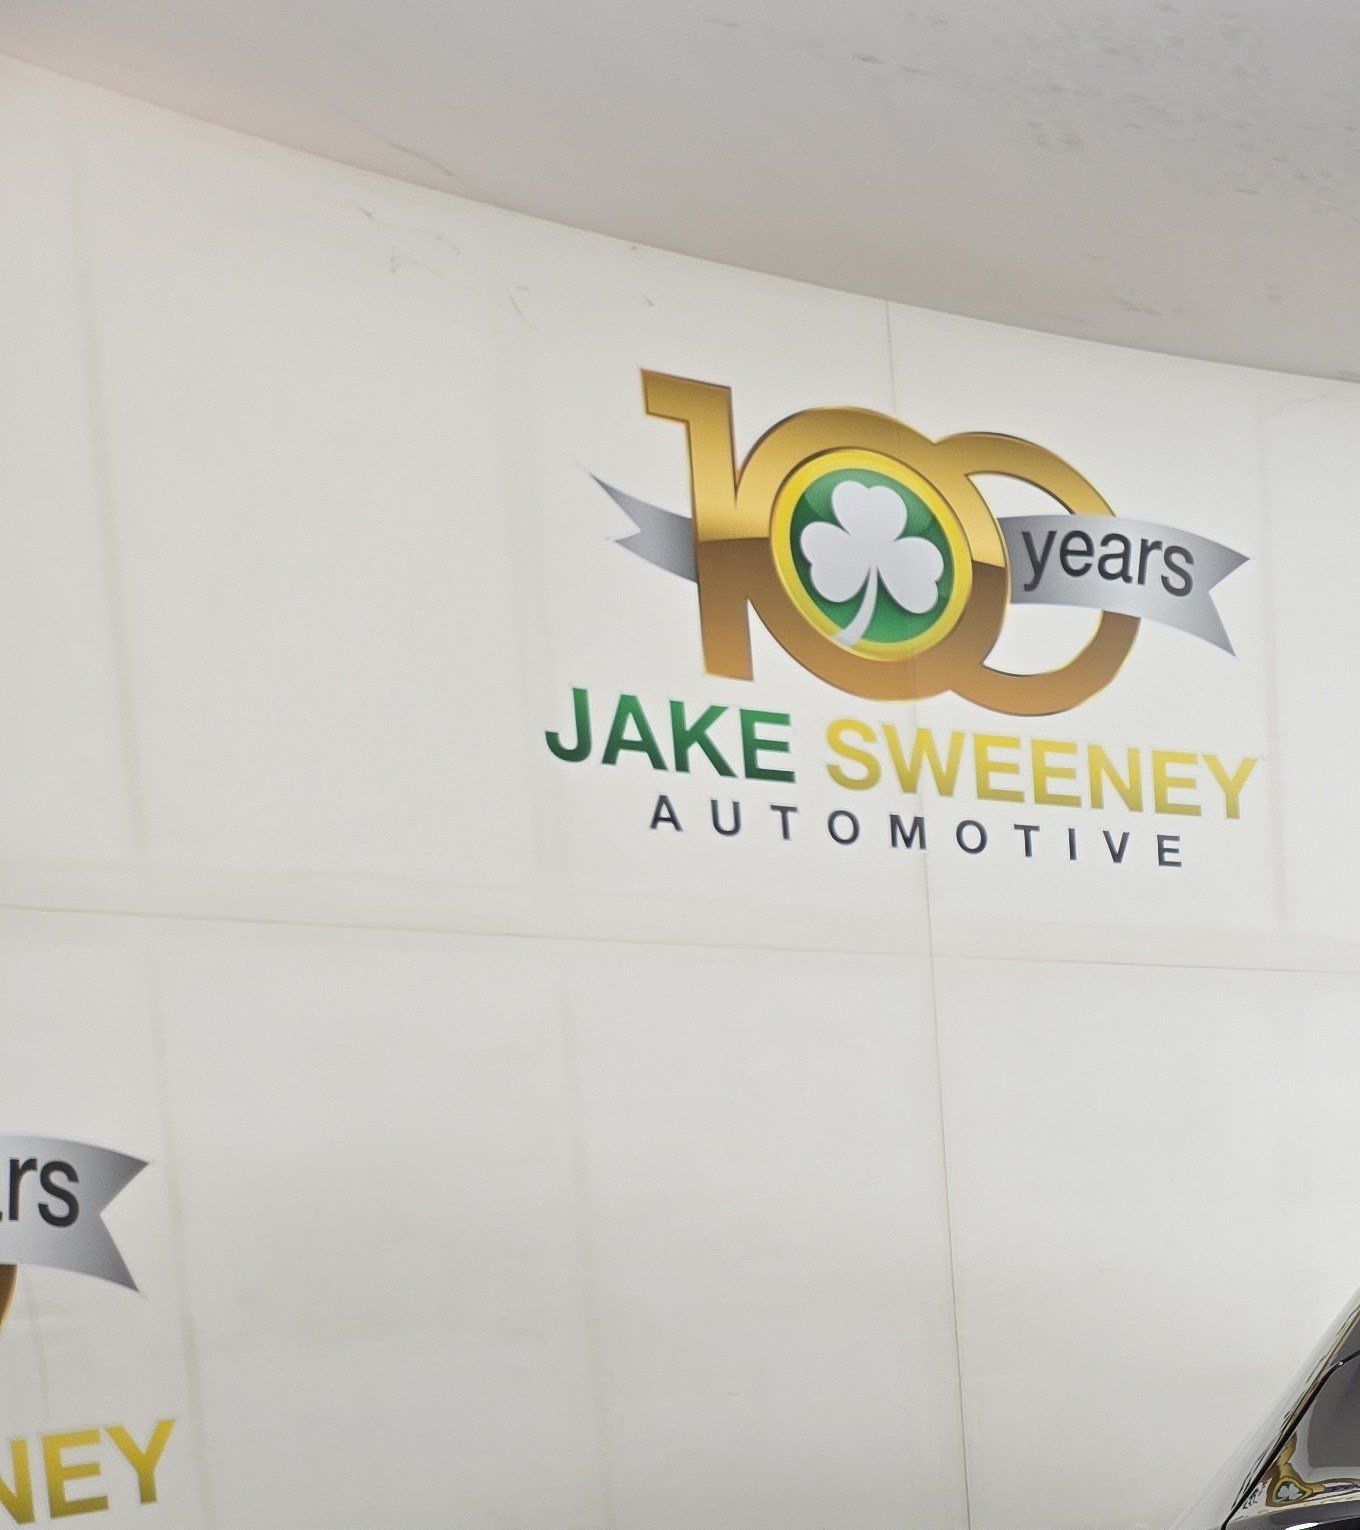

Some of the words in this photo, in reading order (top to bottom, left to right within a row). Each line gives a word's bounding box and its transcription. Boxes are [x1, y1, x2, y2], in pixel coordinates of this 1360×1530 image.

[640, 367, 1142, 717] 100
[1020, 529, 1195, 597] years
[545, 687, 797, 784] JAKE
[825, 718, 1264, 820] SWEENEY
[649, 794, 1183, 868] AUTOMOTIVE
[0, 1158, 80, 1228] rs
